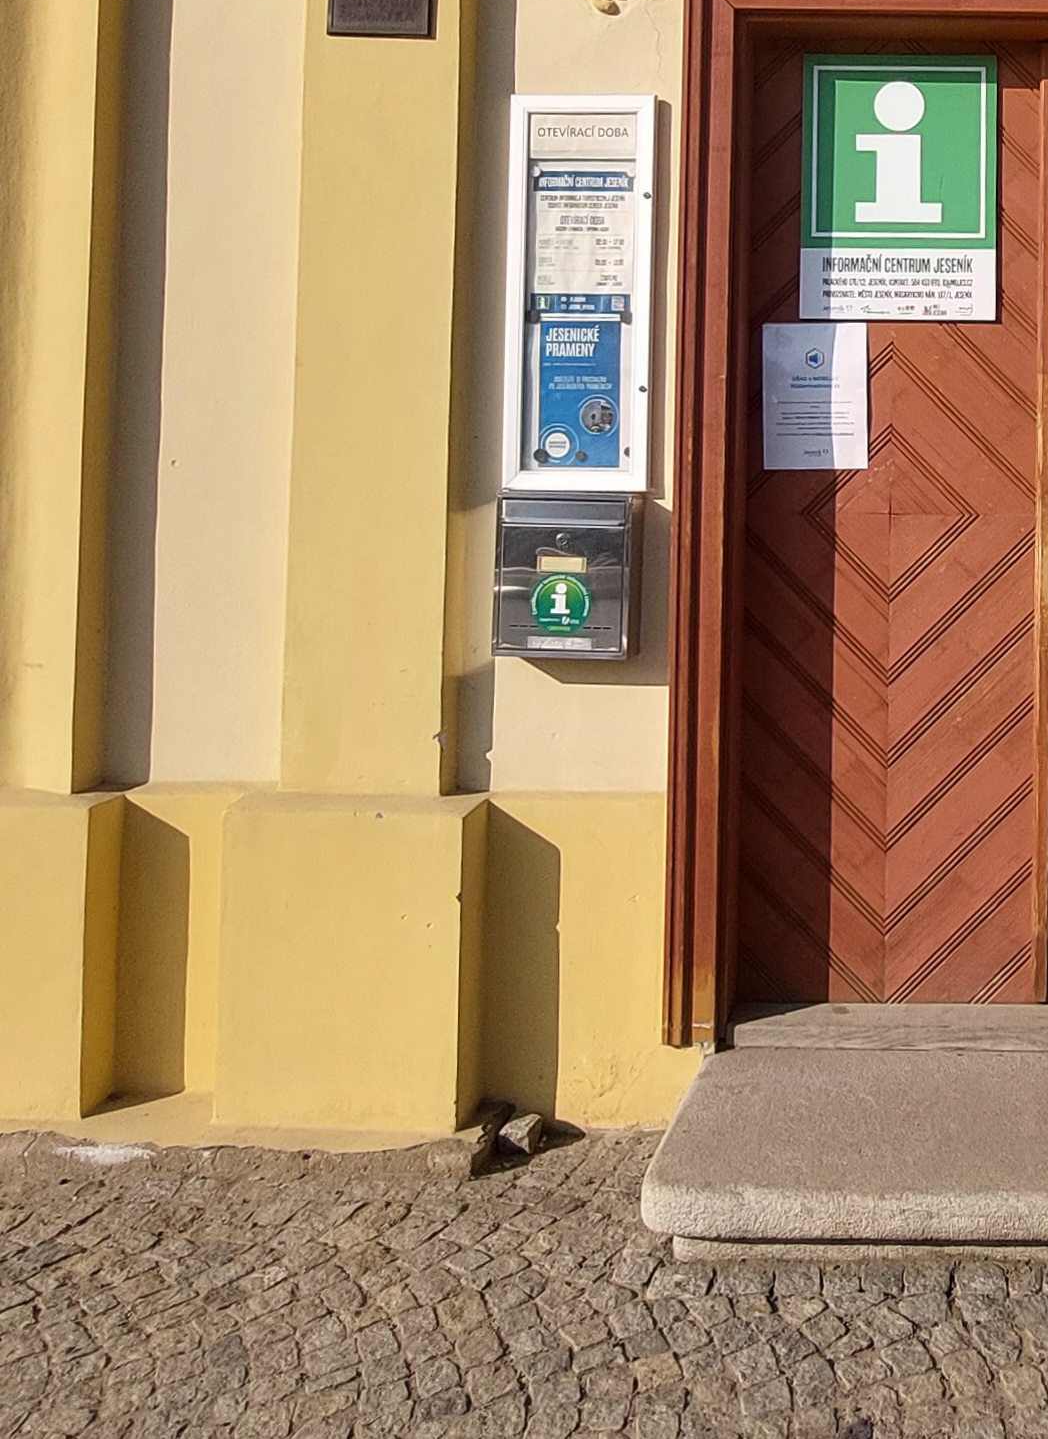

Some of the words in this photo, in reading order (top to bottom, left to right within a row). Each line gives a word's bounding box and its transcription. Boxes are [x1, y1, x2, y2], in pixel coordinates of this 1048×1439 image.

[537, 125, 596, 138] OTEVÍRACÍ
[597, 127, 629, 138] DOBA
[822, 253, 883, 273] INFORMAČNÍ
[884, 257, 931, 273] CENTRUM
[933, 254, 974, 274] JESENÍK
[545, 325, 600, 342] JESENICKÉ
[545, 342, 595, 358] PRAMENY
